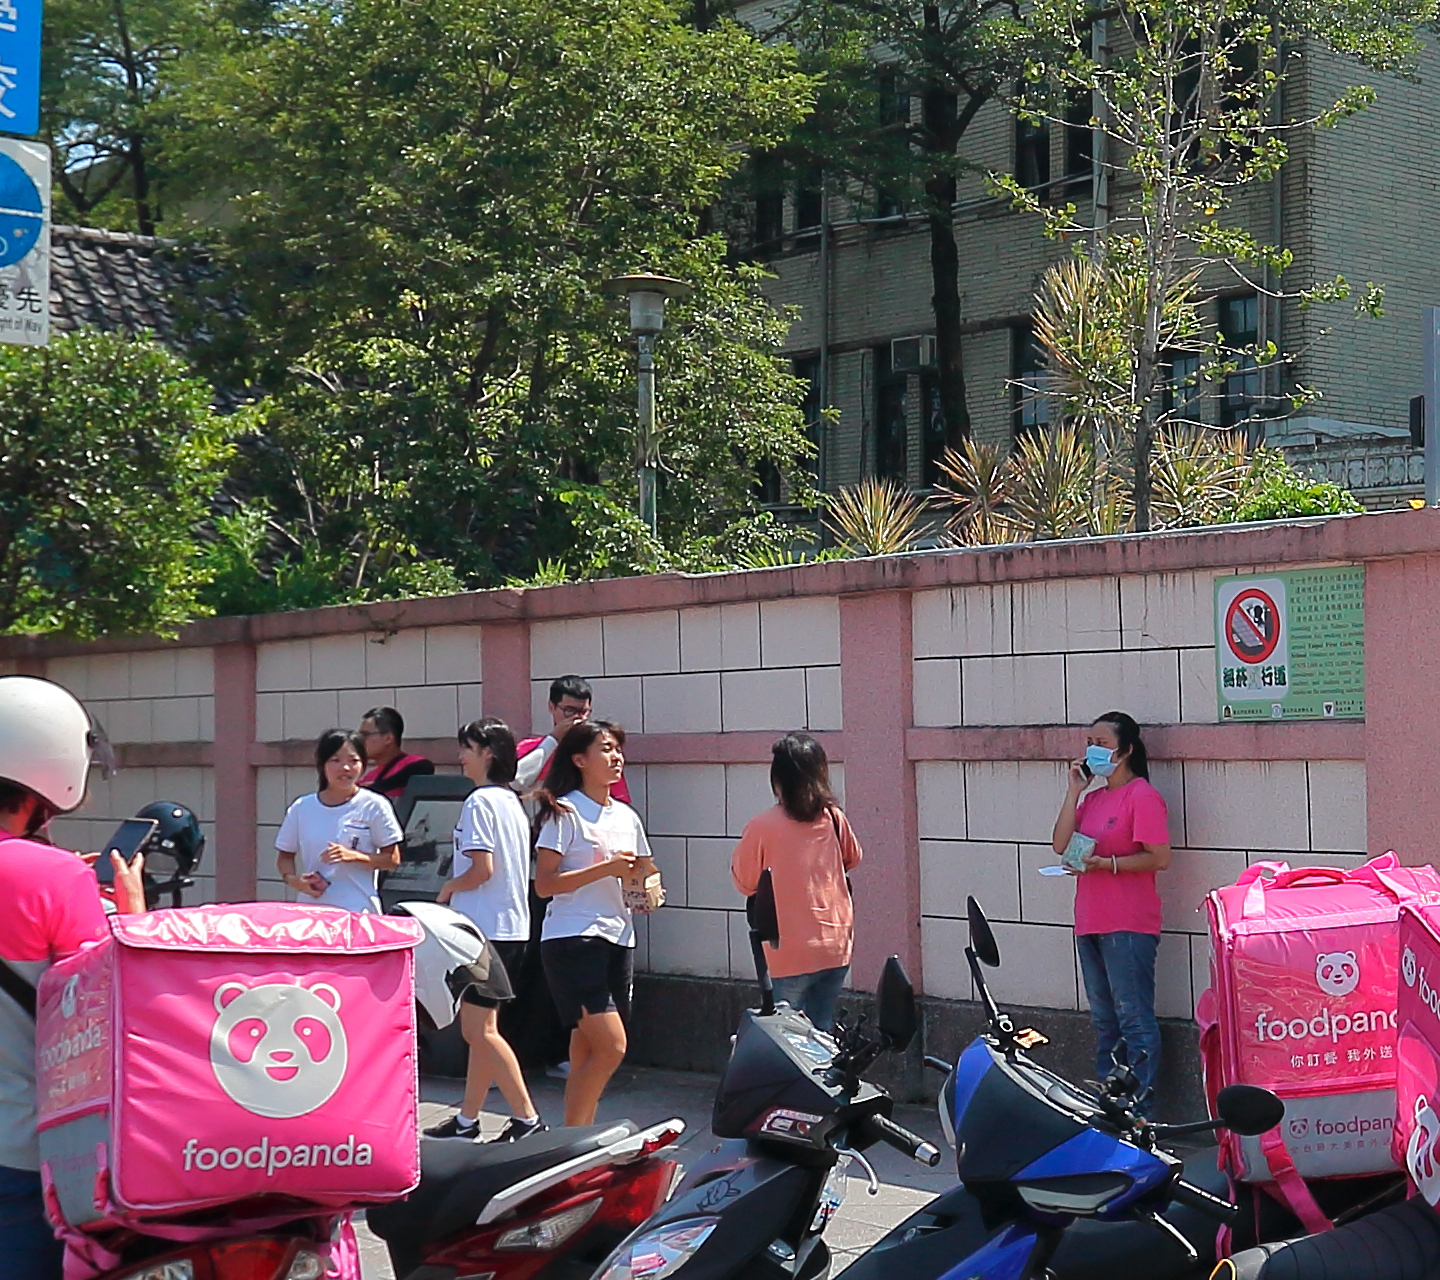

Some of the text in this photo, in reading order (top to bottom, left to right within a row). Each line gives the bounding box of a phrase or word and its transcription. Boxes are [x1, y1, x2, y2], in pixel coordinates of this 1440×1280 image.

[1255, 1008, 1398, 1043] foodpan
[1291, 1046, 1394, 1068] 你訂餐 我外送
[1315, 1116, 1394, 1137] foodpan
[183, 1134, 373, 1176] foodpanda
